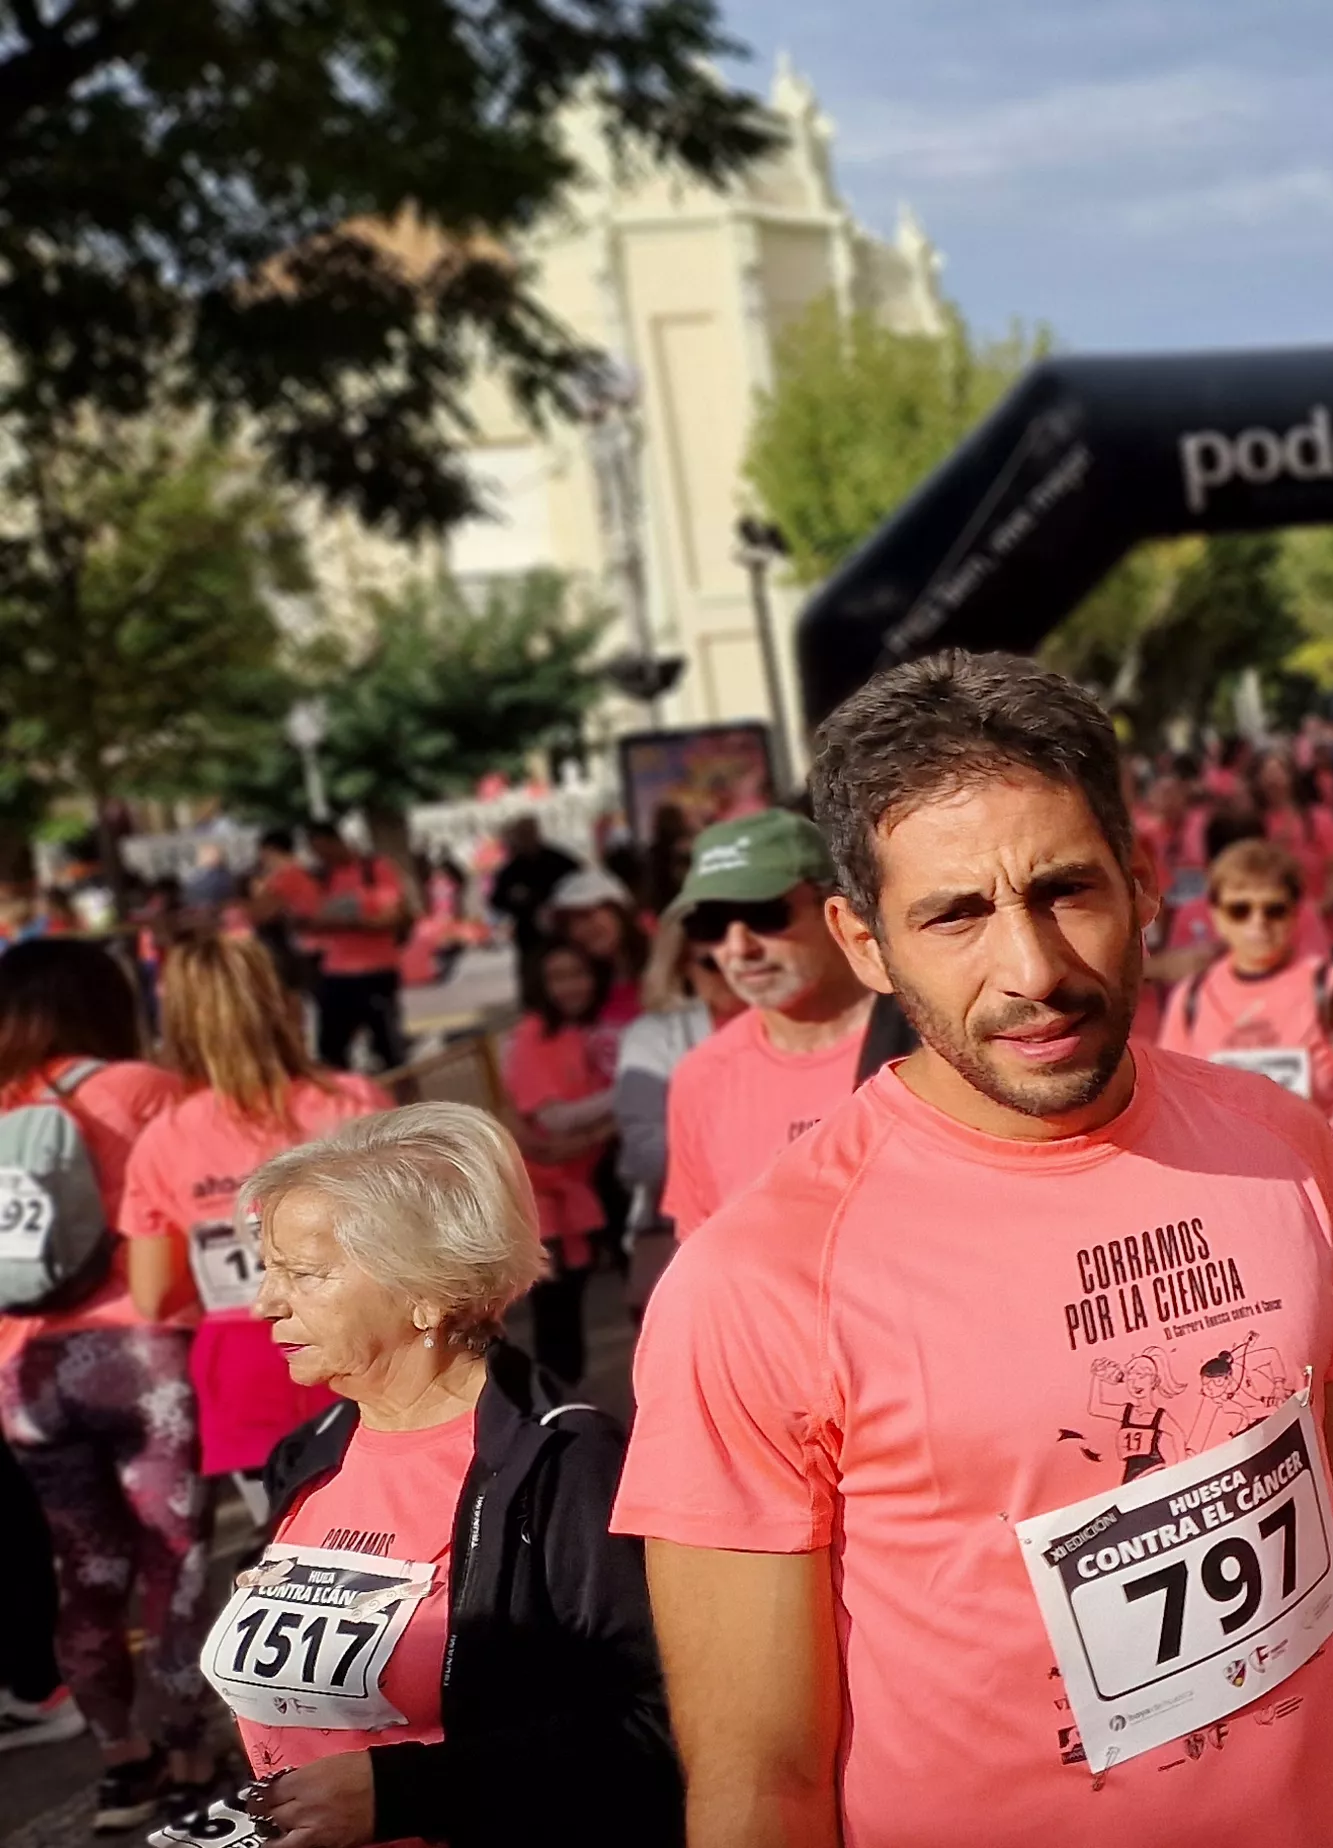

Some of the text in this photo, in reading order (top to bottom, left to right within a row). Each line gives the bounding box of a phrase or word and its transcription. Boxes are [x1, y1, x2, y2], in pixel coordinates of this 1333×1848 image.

[1077, 1217, 1210, 1294] CORRAMOS
[1065, 1257, 1246, 1350] POR LA CIENCIA
[1065, 1513, 1117, 1551] EDICIÓN
[1076, 1450, 1304, 1578] CONTRA EL CÁNCER
[1169, 1470, 1248, 1517] HUESCA
[321, 1528, 396, 1557] CORRAMOS
[1123, 1497, 1297, 1666] 797
[233, 1608, 379, 1687] 1517
[443, 1634, 458, 1687] TSUNAMI
